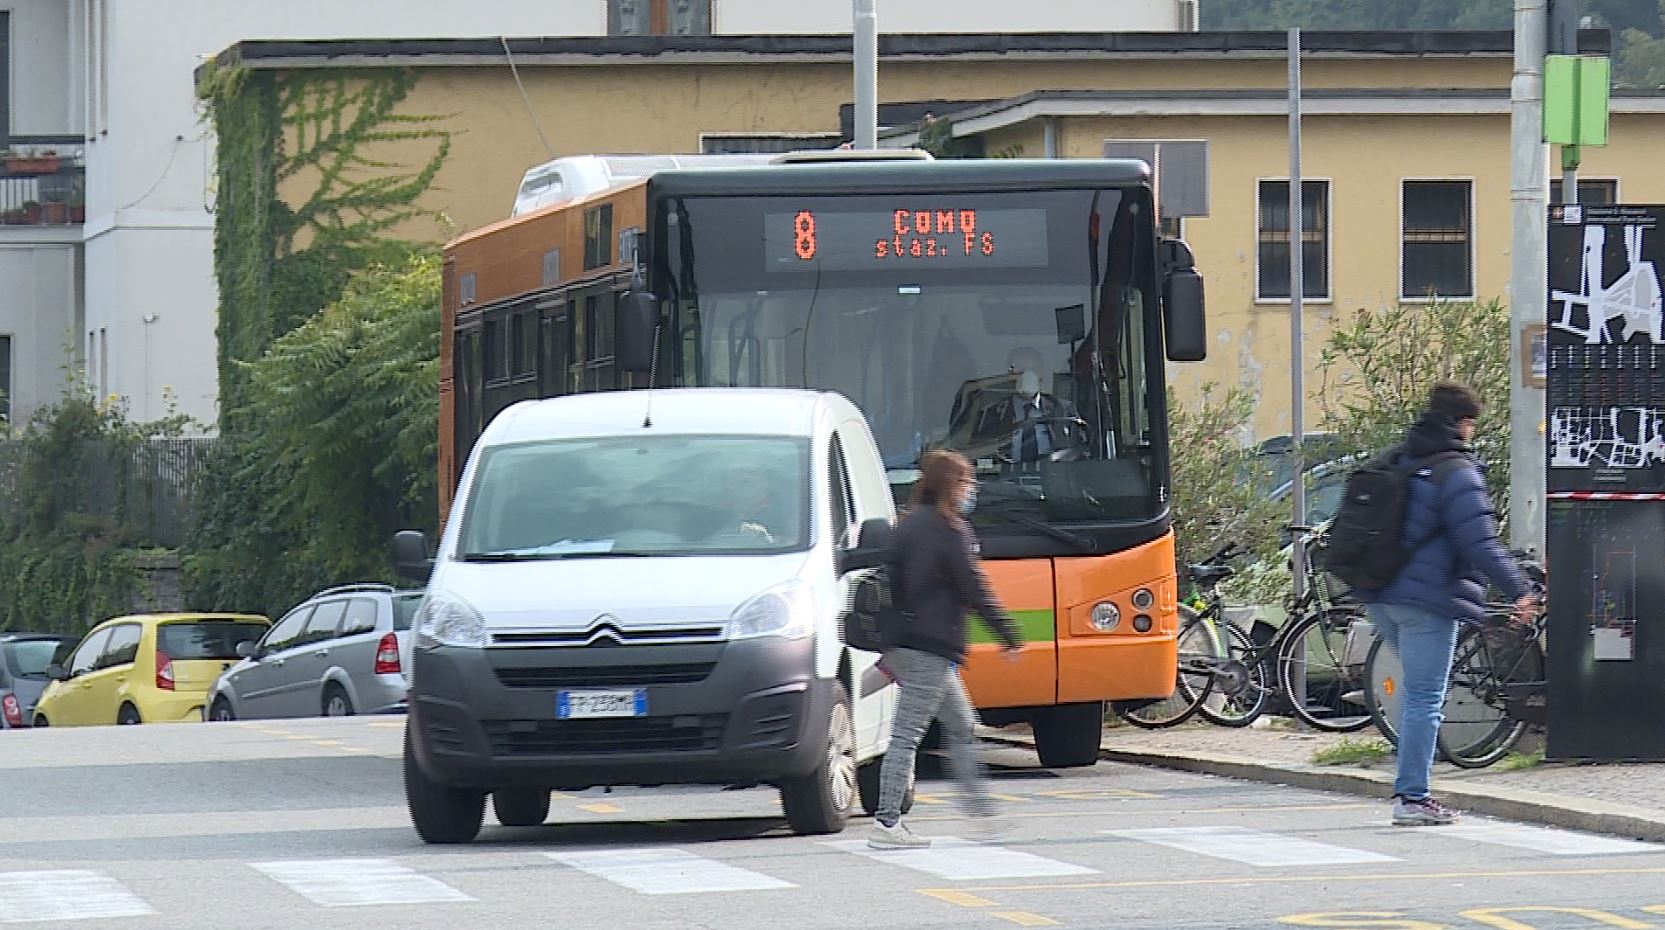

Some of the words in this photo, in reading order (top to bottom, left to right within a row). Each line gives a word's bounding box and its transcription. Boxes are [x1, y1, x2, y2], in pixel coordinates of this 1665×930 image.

[894, 210, 977, 234] COMO
[795, 210, 817, 259] 8
[964, 231, 993, 255] FS
